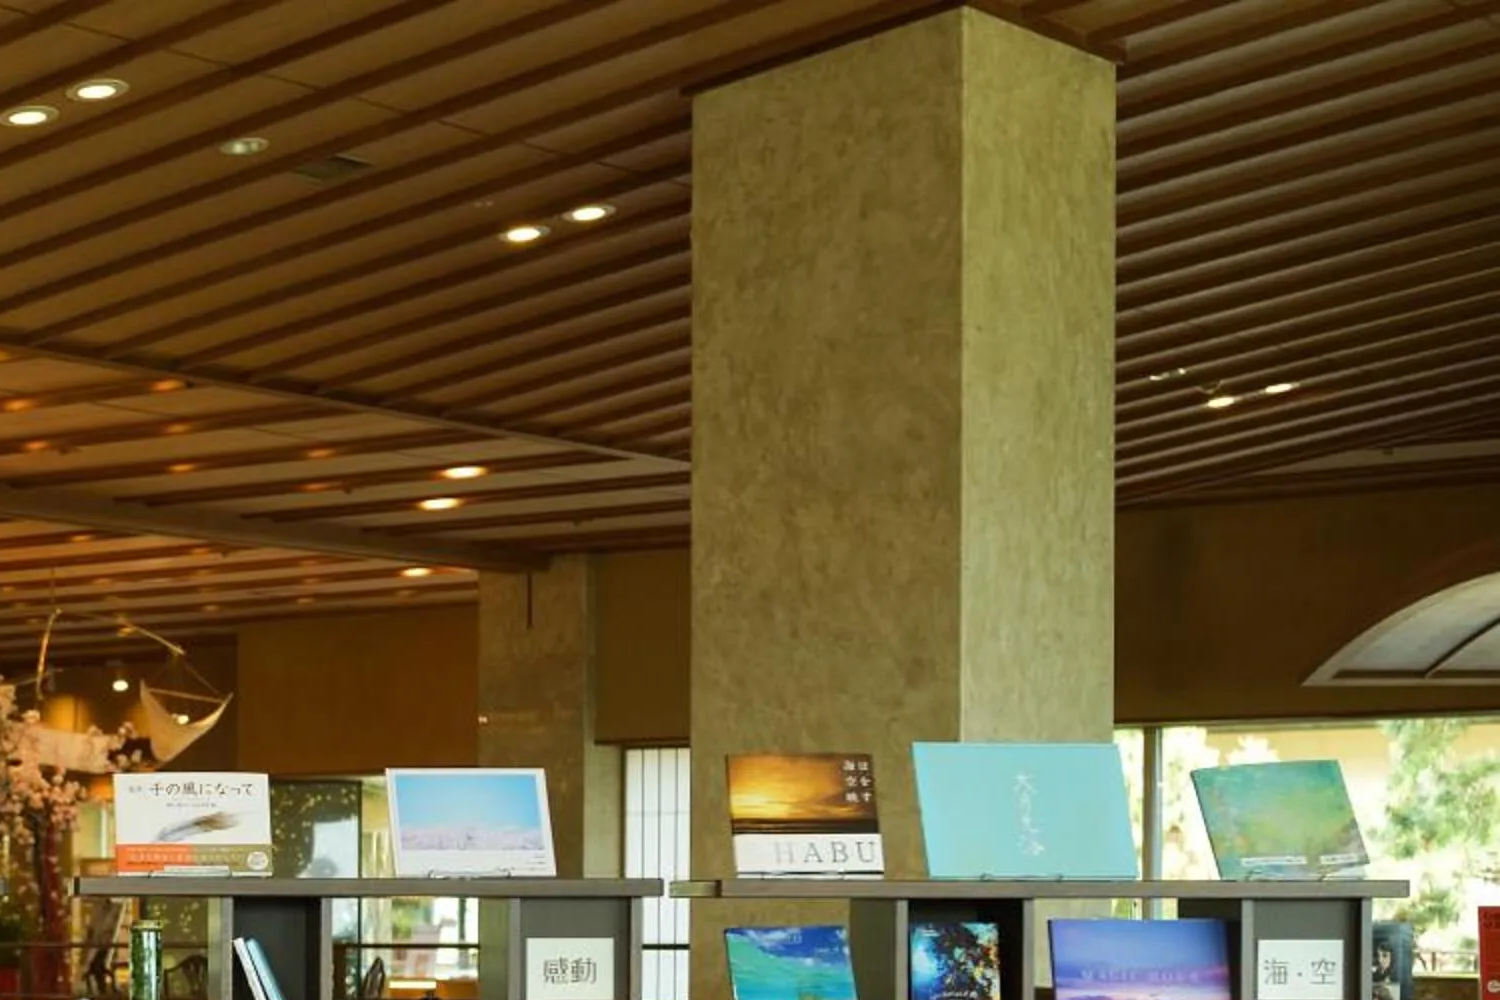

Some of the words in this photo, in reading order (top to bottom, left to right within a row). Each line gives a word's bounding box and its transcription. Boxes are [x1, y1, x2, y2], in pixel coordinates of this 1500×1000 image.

[149, 780, 254, 797] 千の風になって
[773, 840, 877, 865] HABU
[543, 957, 597, 985] 感動
[1263, 957, 1336, 985] 海・空
